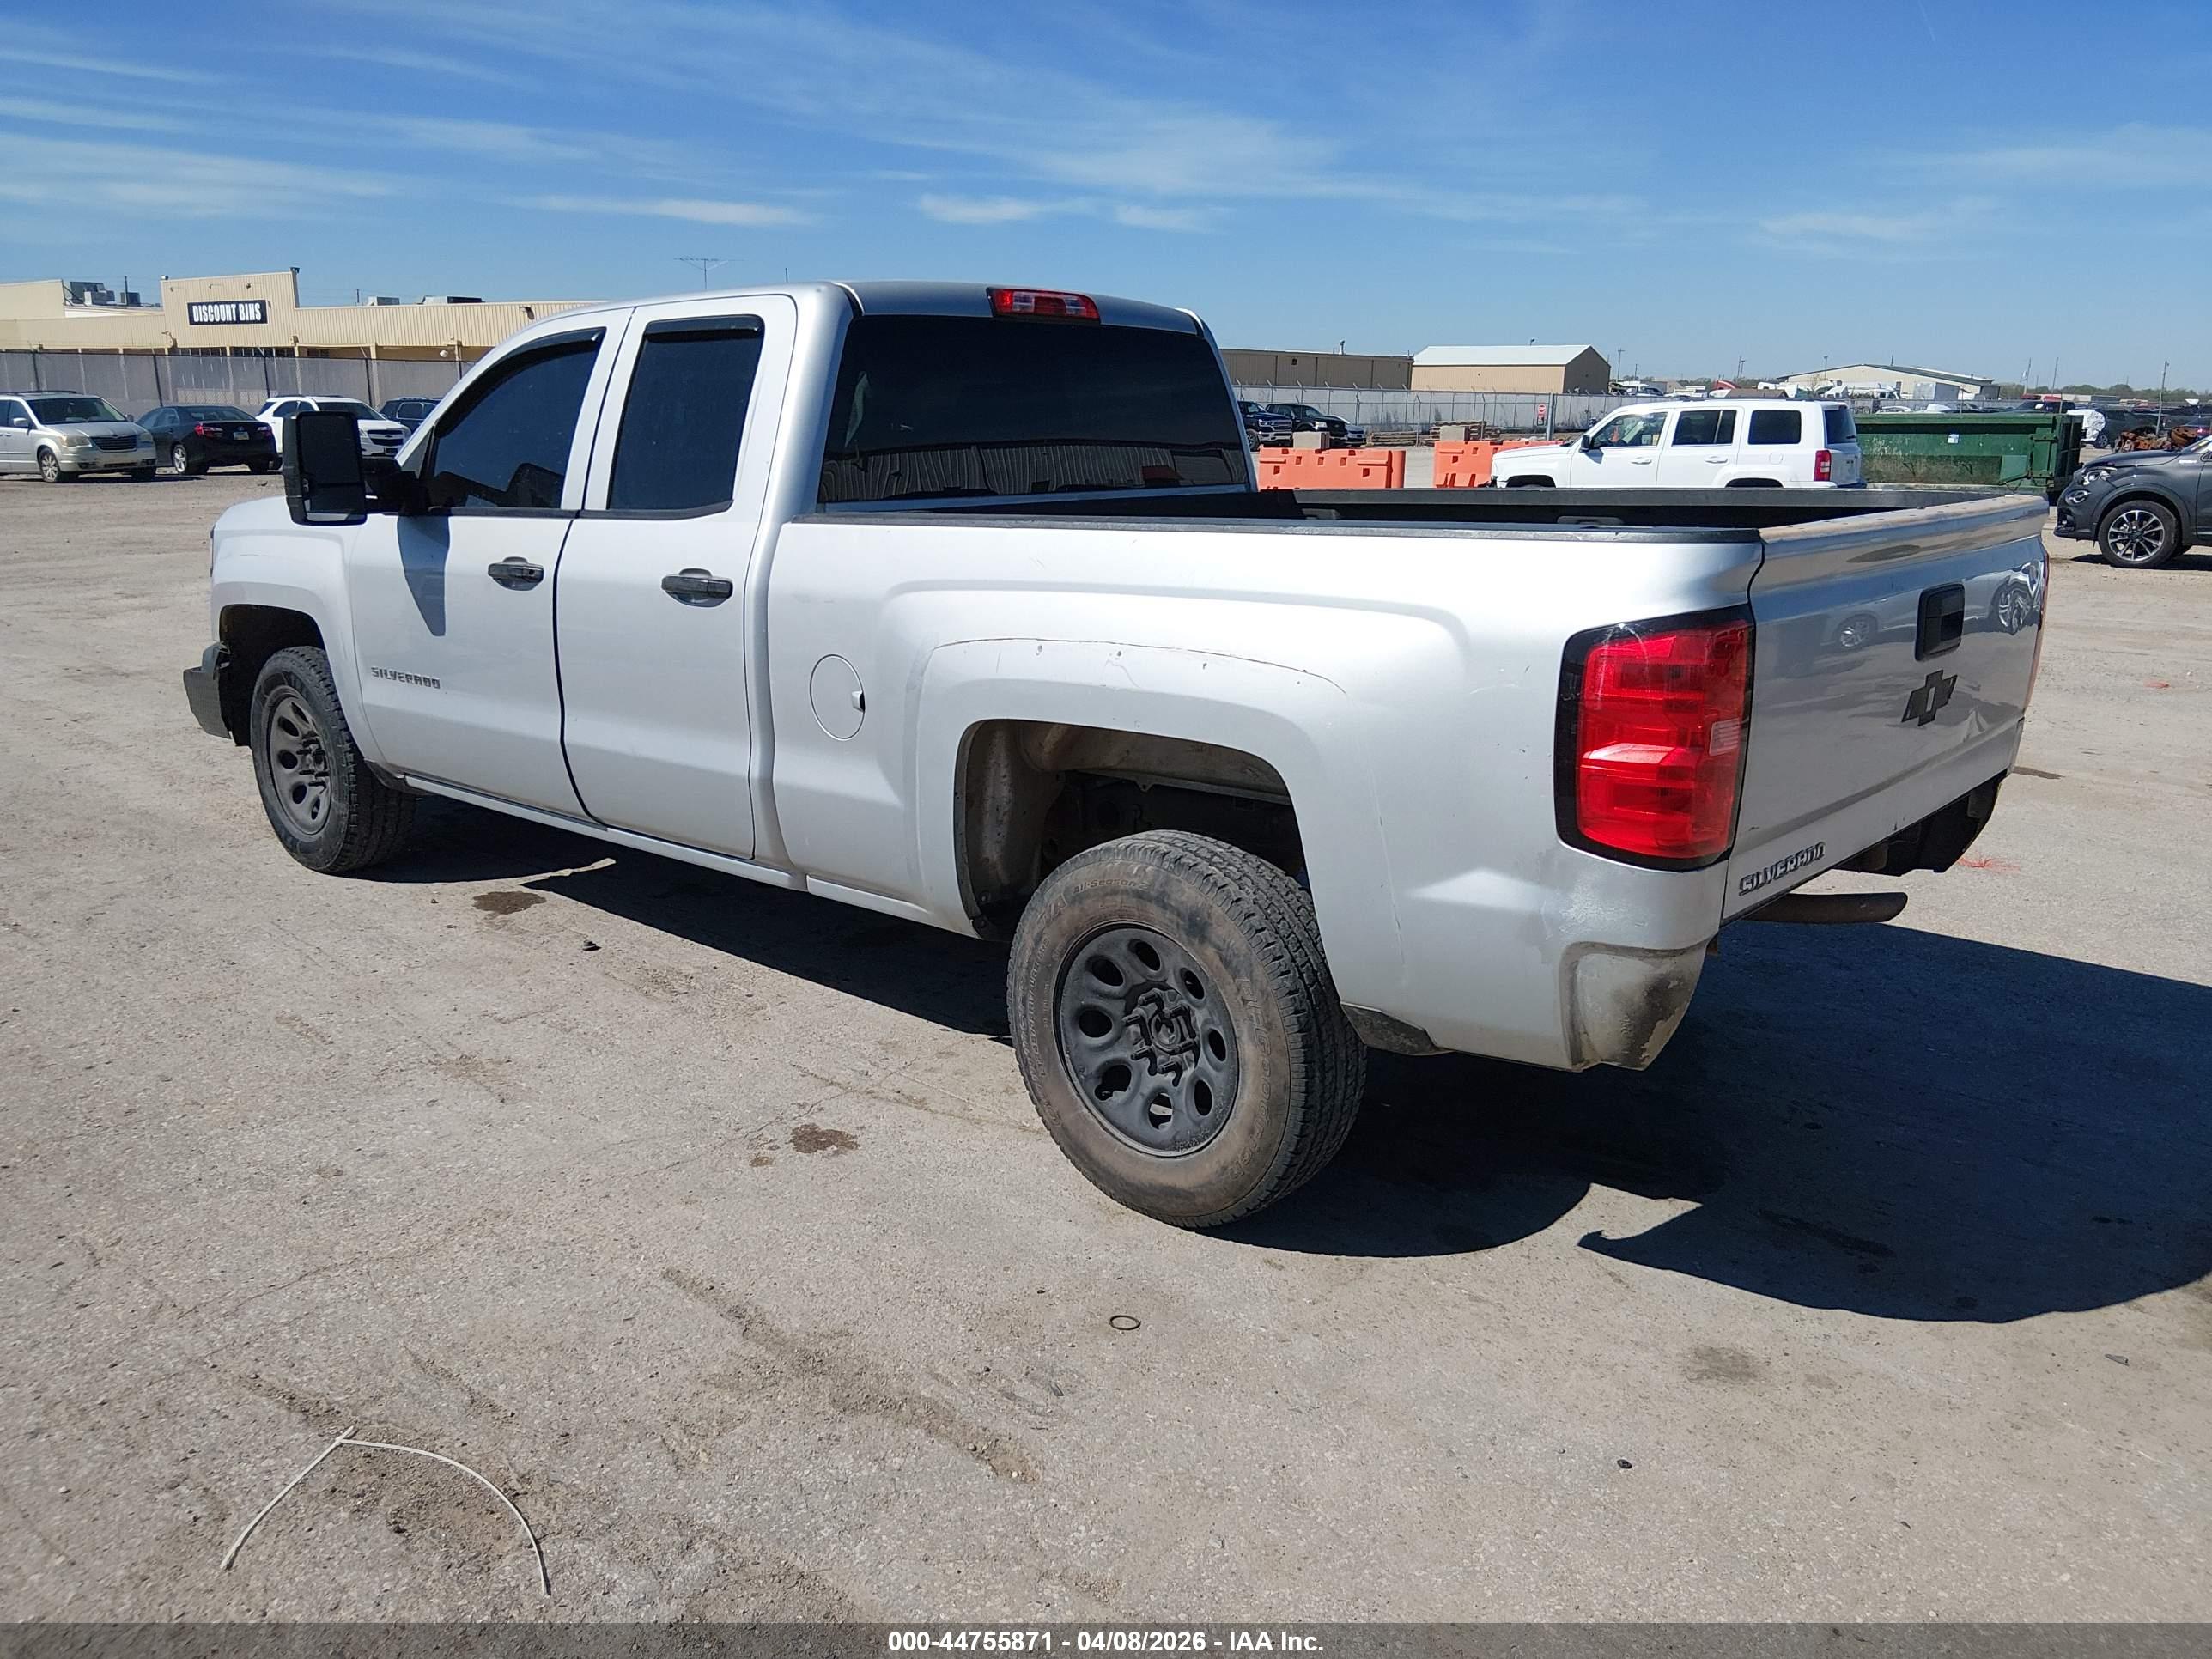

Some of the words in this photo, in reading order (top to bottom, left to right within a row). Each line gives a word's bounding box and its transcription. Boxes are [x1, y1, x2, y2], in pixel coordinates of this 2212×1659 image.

[192, 303, 236, 322] DISCOUNT
[238, 302, 262, 321] BINS
[371, 666, 441, 689] SILVERADO
[1739, 842, 1826, 896] SILVERADO
